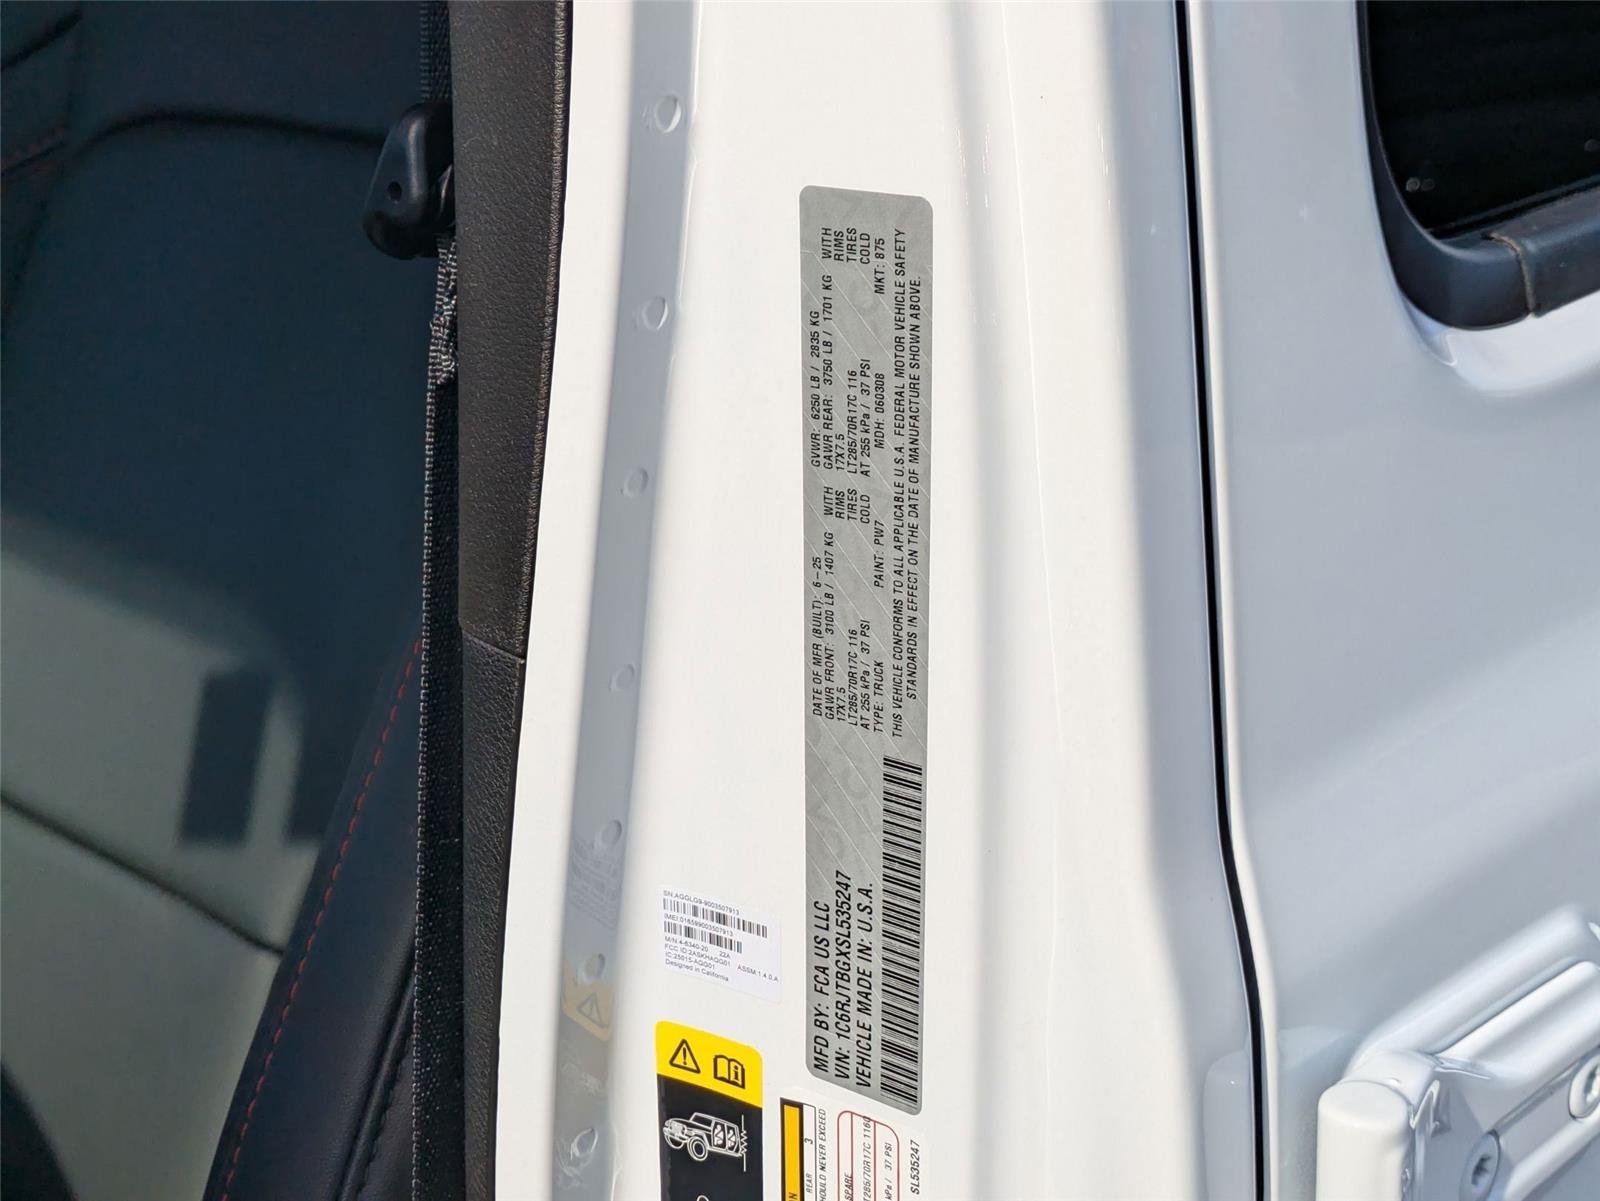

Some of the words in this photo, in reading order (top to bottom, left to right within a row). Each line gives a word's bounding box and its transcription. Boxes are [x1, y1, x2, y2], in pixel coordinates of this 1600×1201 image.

[822, 227, 831, 259] WITH
[834, 230, 844, 262] RIMS
[847, 227, 857, 263] TIRES
[860, 233, 870, 265] COLD
[875, 238, 885, 260] 875
[894, 228, 905, 276] SAFETY
[822, 275, 832, 291] KG
[875, 264, 885, 294] MKT:
[823, 297, 832, 322] 1701
[894, 280, 905, 331] VEHICLE
[909, 276, 920, 320] ABOVE.
[810, 310, 819, 327] KG
[810, 331, 820, 358] 2835
[823, 340, 832, 354] LB
[894, 336, 905, 378] MOTOR
[909, 324, 920, 370] SHOWN
[811, 375, 820, 389] LB
[823, 359, 832, 386] 3750
[847, 370, 857, 390] 116
[860, 359, 870, 378] PSI
[860, 381, 870, 396] 37
[875, 373, 885, 414] 060308
[811, 394, 820, 420] 6250
[823, 395, 832, 431] REAR:
[894, 383, 905, 437] FEDERAL
[909, 374, 920, 464] MANUFACTURE
[847, 395, 857, 474] LT285/70R17C
[860, 413, 870, 434] kPa
[875, 418, 885, 449] MDH:
[811, 429, 820, 467] GVWR:
[823, 434, 833, 469] GAWR
[835, 433, 845, 471] 17X7.5
[860, 437, 870, 458] 255
[894, 442, 904, 477] U.S.A.
[860, 463, 870, 477] AT
[909, 468, 919, 484] OF
[824, 486, 833, 516] WITH
[835, 490, 845, 519] RIMS
[847, 488, 857, 521] TIRES
[860, 495, 870, 524] COLD
[908, 487, 919, 518] DATE
[893, 482, 904, 552] APPLICABLE
[824, 532, 834, 547] KG
[874, 520, 884, 546] PW7
[908, 522, 918, 545] THE
[824, 550, 834, 576] 1407
[874, 551, 884, 588] PAINT:
[893, 556, 904, 577] ALL
[908, 549, 918, 566] ON
[824, 593, 834, 605] LB
[893, 580, 903, 594] TO
[907, 570, 917, 612] EFFECT
[812, 596, 823, 639] (BUILT):
[825, 609, 834, 635] 3100
[860, 619, 870, 637] PSI
[892, 598, 903, 661] CONFORMS
[907, 616, 917, 628] IN
[848, 629, 857, 648] 116
[860, 641, 870, 654] 37
[812, 643, 822, 666] MFR
[825, 642, 834, 683] FRONT:
[907, 632, 917, 700] STANDARDS
[813, 670, 822, 684] OF
[848, 652, 858, 727] LT285/70R17C
[860, 670, 870, 690] kPa
[874, 661, 883, 697] TRUCK
[892, 664, 903, 709] VEHICLE
[813, 688, 822, 716] DATE
[825, 687, 834, 720] GAWR
[837, 687, 846, 722] 17X7.5
[860, 693, 870, 712] 255
[860, 715, 870, 730] AT
[874, 701, 884, 733] TYPE:
[892, 713, 902, 738] THIS
[814, 900, 829, 931] LLC
[857, 882, 873, 932] U.S.A.
[814, 936, 829, 958] US
[835, 870, 851, 1040] 1C6RJTBGXSL535247
[857, 938, 872, 963] IN:
[665, 959, 694, 970] Designed
[701, 968, 729, 981] California
[814, 965, 829, 996] FCA
[857, 968, 872, 1016] MADE
[814, 1004, 829, 1031] BY:
[814, 1036, 829, 1073] MFD
[835, 1047, 850, 1080] VIN:
[856, 1022, 872, 1088] VEHICLE
[818, 1109, 827, 1141] EXCEED
[818, 1144, 827, 1171] NEVER
[884, 1143, 892, 1157] PSI
[884, 1160, 892, 1170] 37
[910, 1139, 920, 1194] SL535247
[844, 1173, 852, 1201] SPARE
